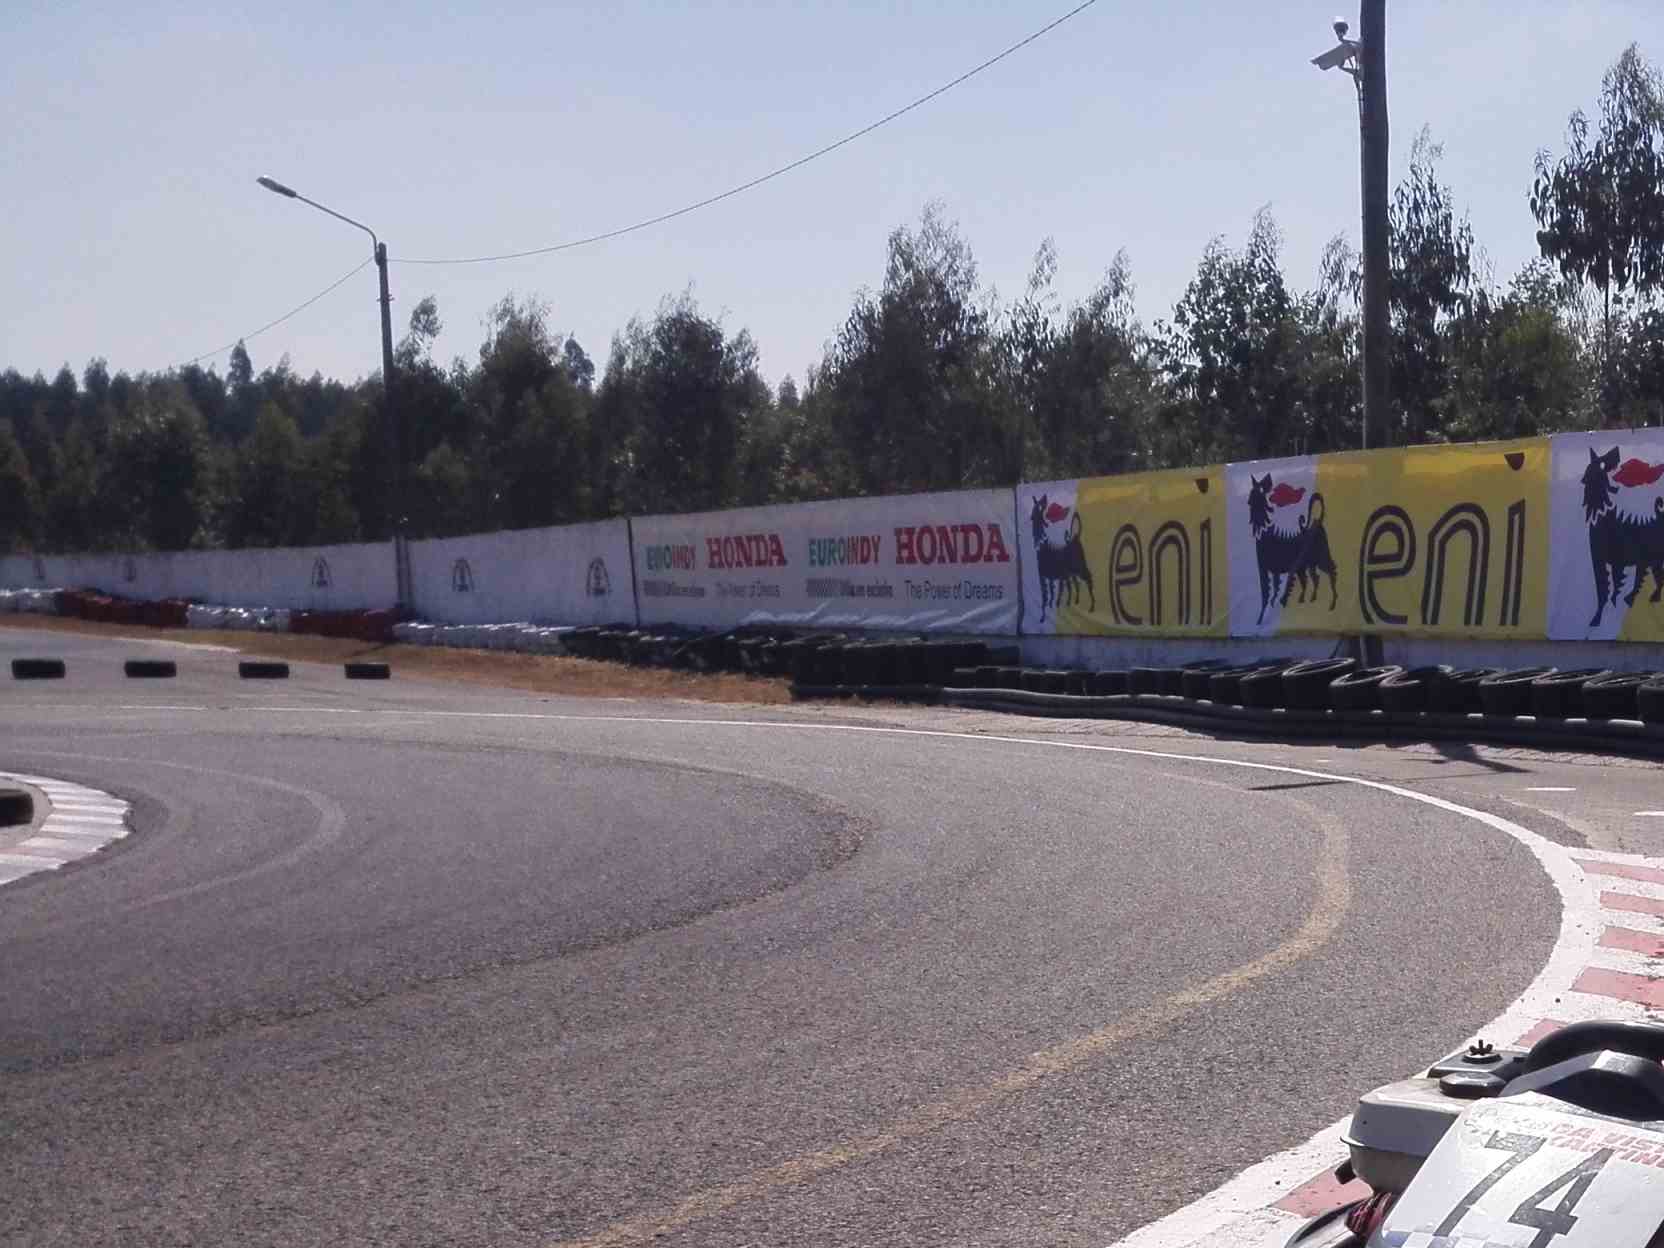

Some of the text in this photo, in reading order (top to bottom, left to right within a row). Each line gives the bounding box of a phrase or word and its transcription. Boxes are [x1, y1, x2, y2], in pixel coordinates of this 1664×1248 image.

[705, 533, 788, 569] HONDA
[894, 523, 1010, 565] HONDA
[1109, 478, 1212, 626] eni
[1358, 452, 1525, 626] eni
